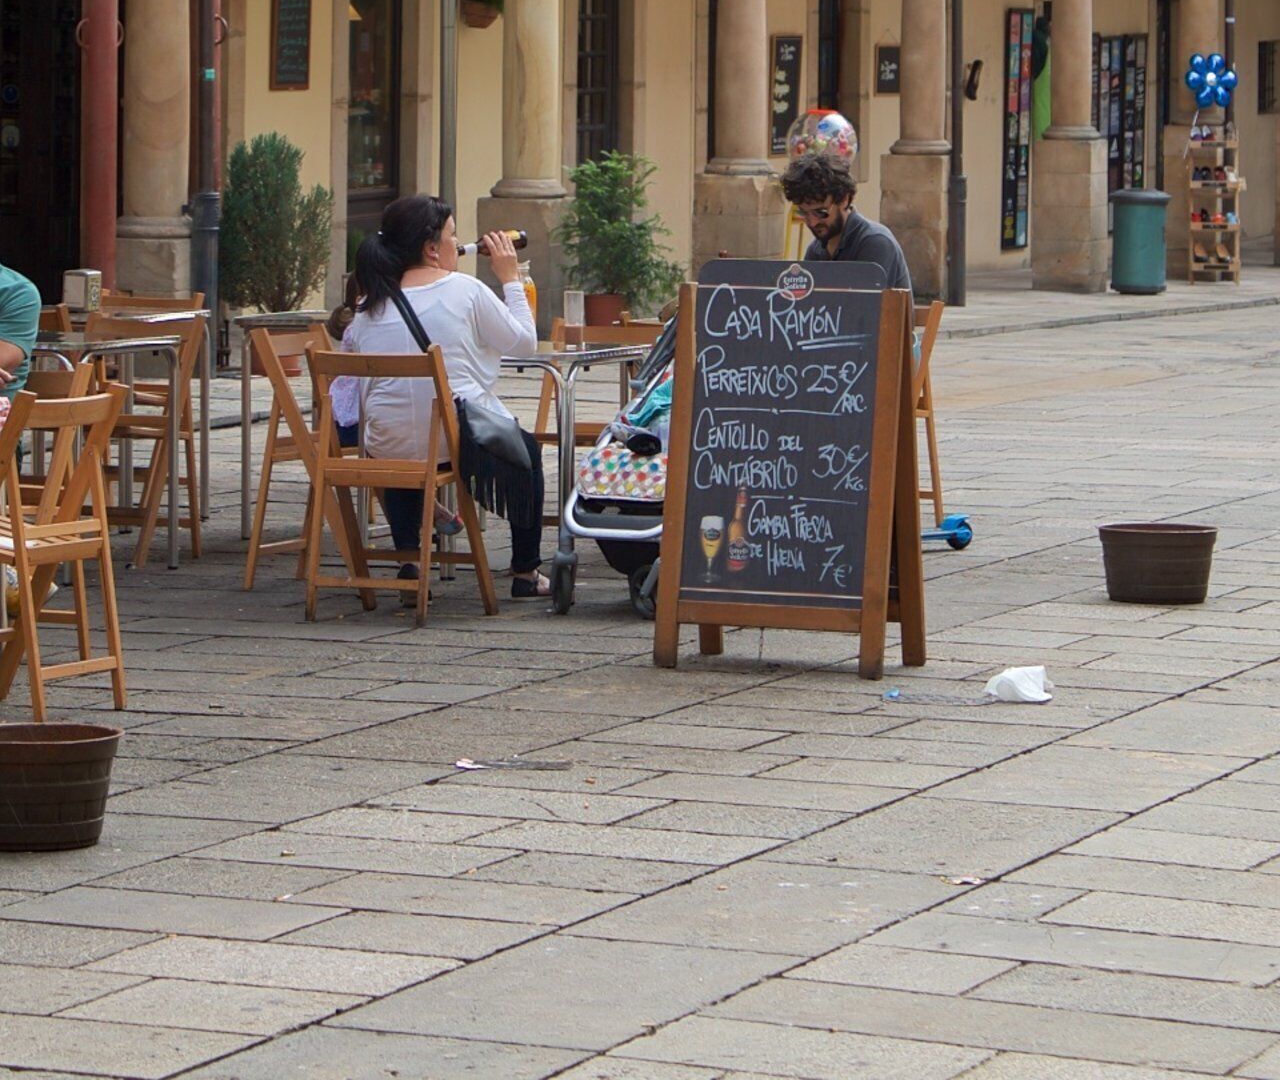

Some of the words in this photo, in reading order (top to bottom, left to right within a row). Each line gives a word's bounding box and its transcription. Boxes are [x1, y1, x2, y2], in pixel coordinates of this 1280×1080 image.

[704, 283, 763, 340] CASA
[766, 288, 842, 351] RAMÓN
[693, 407, 770, 451] CENTOLLO
[777, 435, 804, 452] DEL
[747, 499, 791, 539] GAMBA
[790, 503, 833, 543] FRESCA
[749, 543, 764, 558] DE
[767, 540, 806, 576] HUELVA
